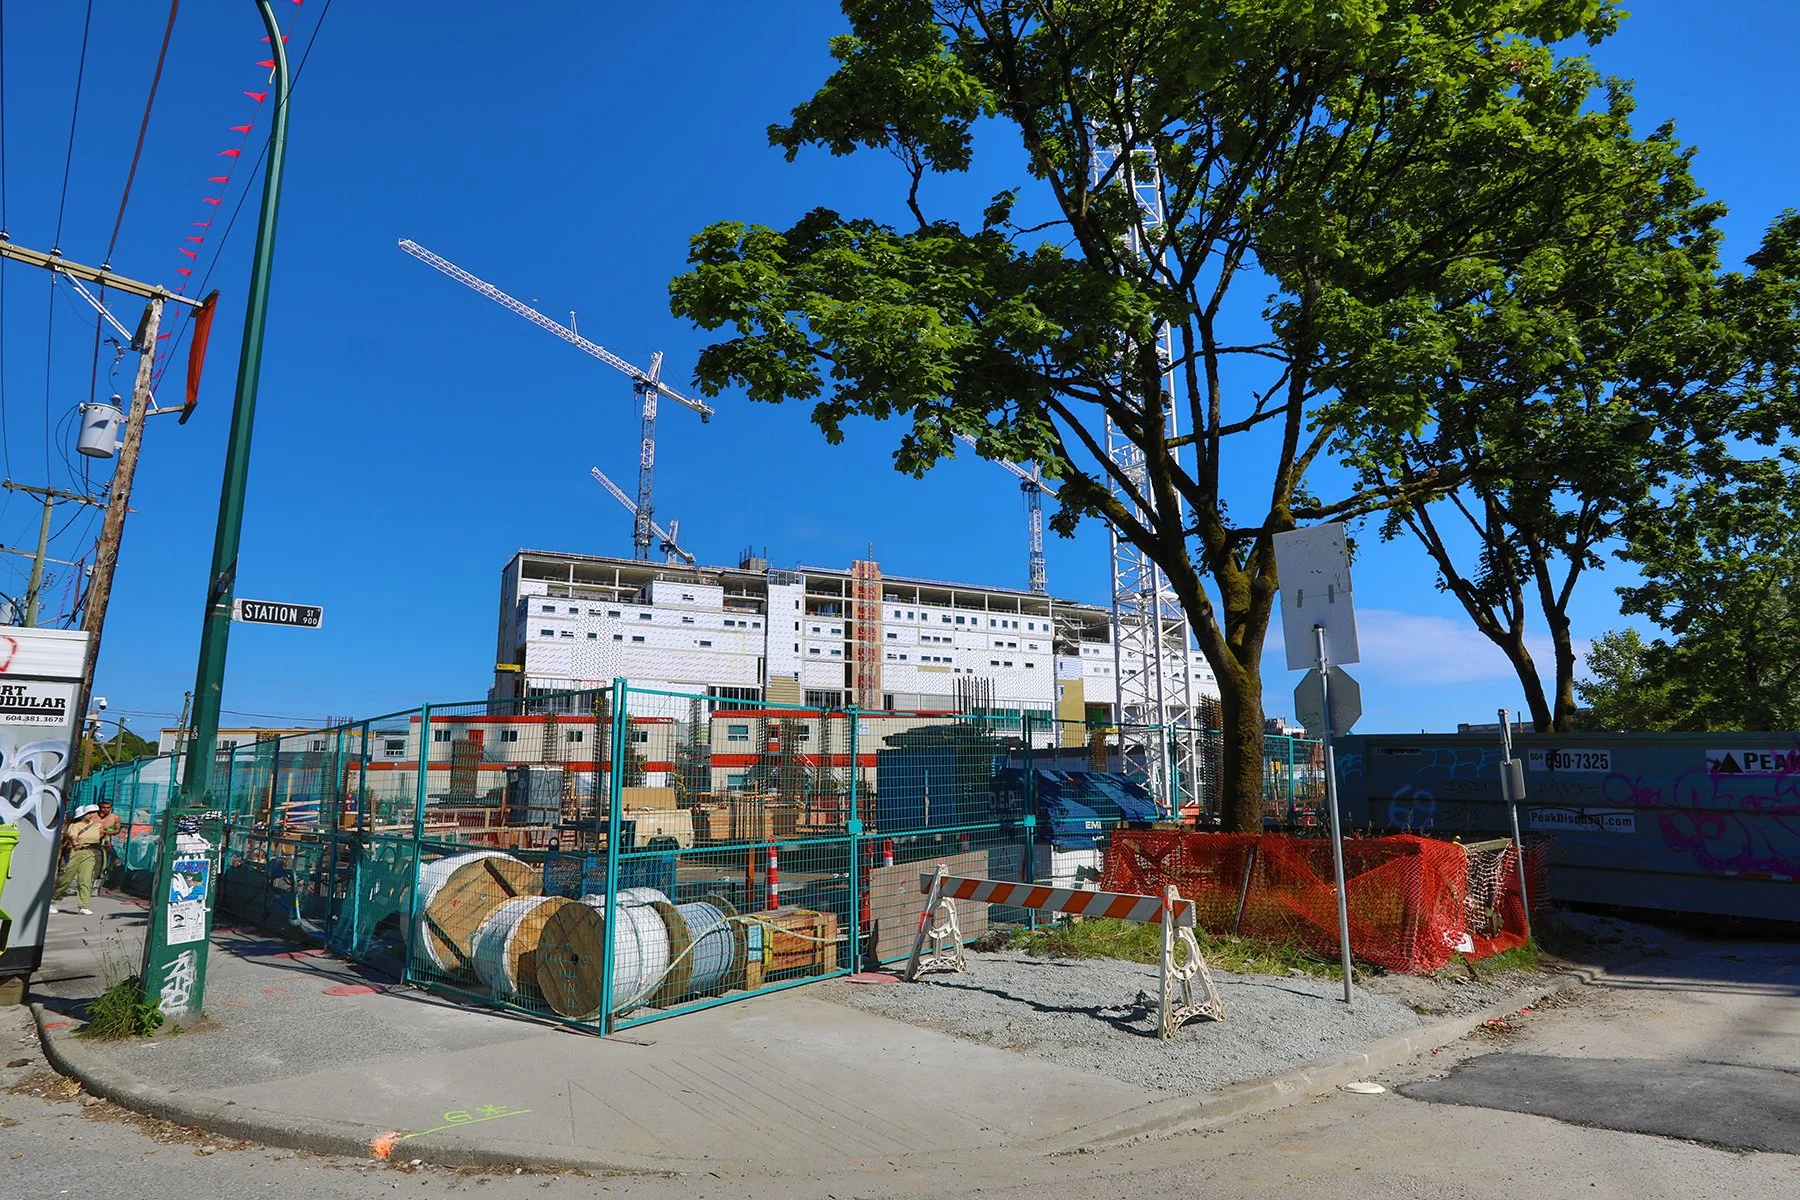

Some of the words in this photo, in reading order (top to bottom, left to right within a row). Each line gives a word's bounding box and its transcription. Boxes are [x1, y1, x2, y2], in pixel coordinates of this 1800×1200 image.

[245, 604, 298, 623] STATION
[307, 609, 315, 617] ST
[303, 617, 318, 625] 900
[0, 685, 27, 696] RT
[6, 715, 64, 723] 604.381.3678
[1744, 753, 1800, 771] PEA
